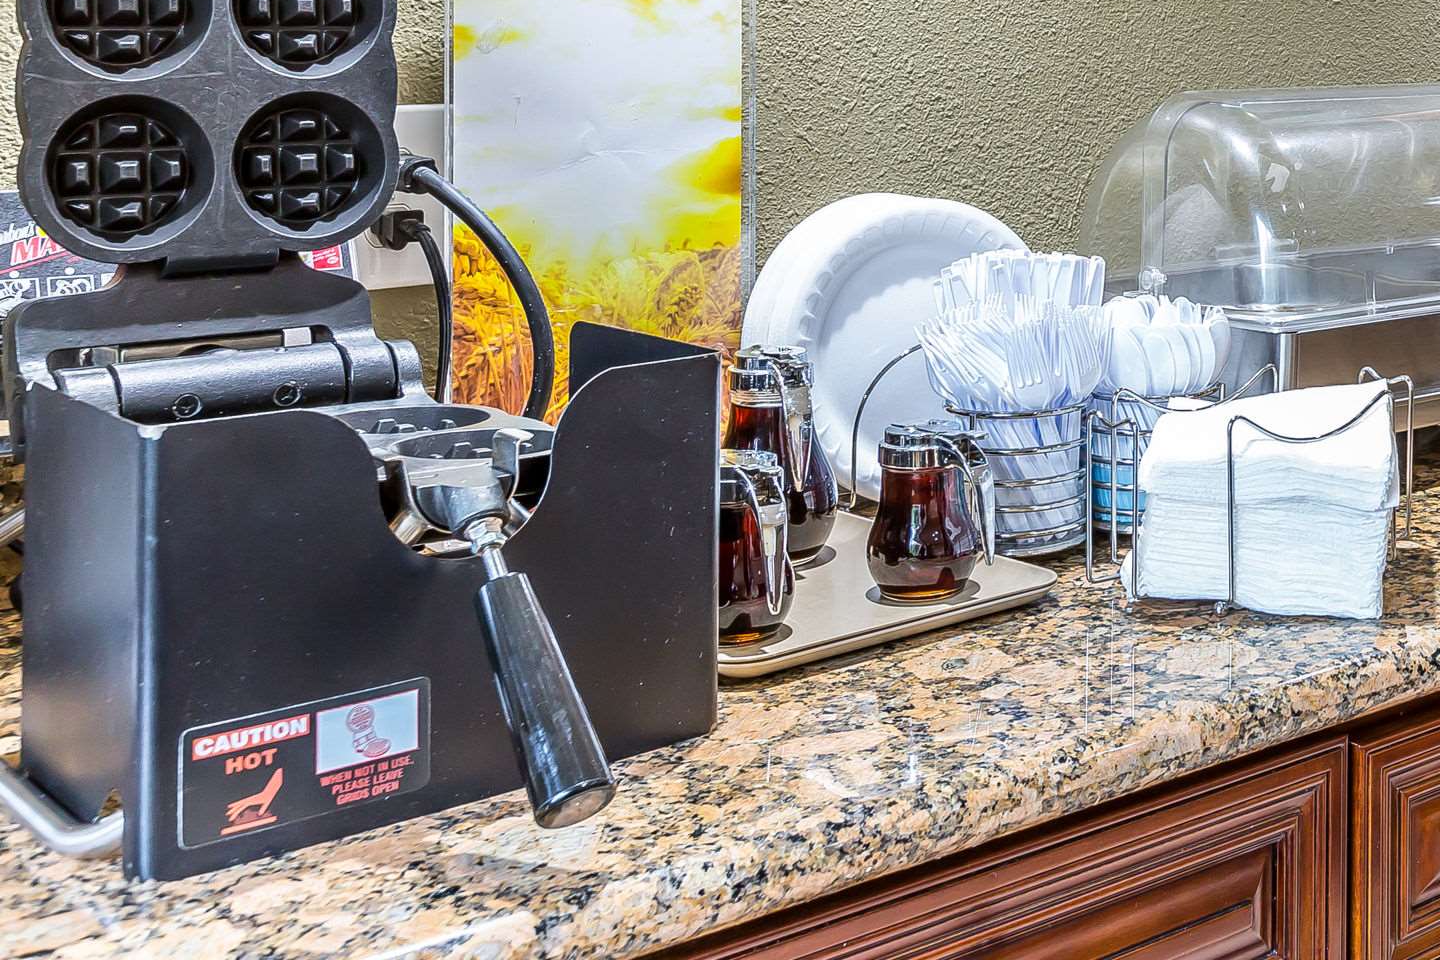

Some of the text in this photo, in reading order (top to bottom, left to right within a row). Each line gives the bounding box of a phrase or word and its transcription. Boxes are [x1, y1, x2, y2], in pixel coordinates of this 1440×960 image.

[10, 235, 66, 266] MA
[194, 717, 307, 757] CAUTION
[225, 748, 278, 775] HOT
[320, 770, 352, 787] WHEN
[354, 764, 375, 779] NOT
[378, 761, 389, 772] IN
[331, 768, 404, 795] PLEASE LEAVE
[371, 780, 400, 796] OPEN
